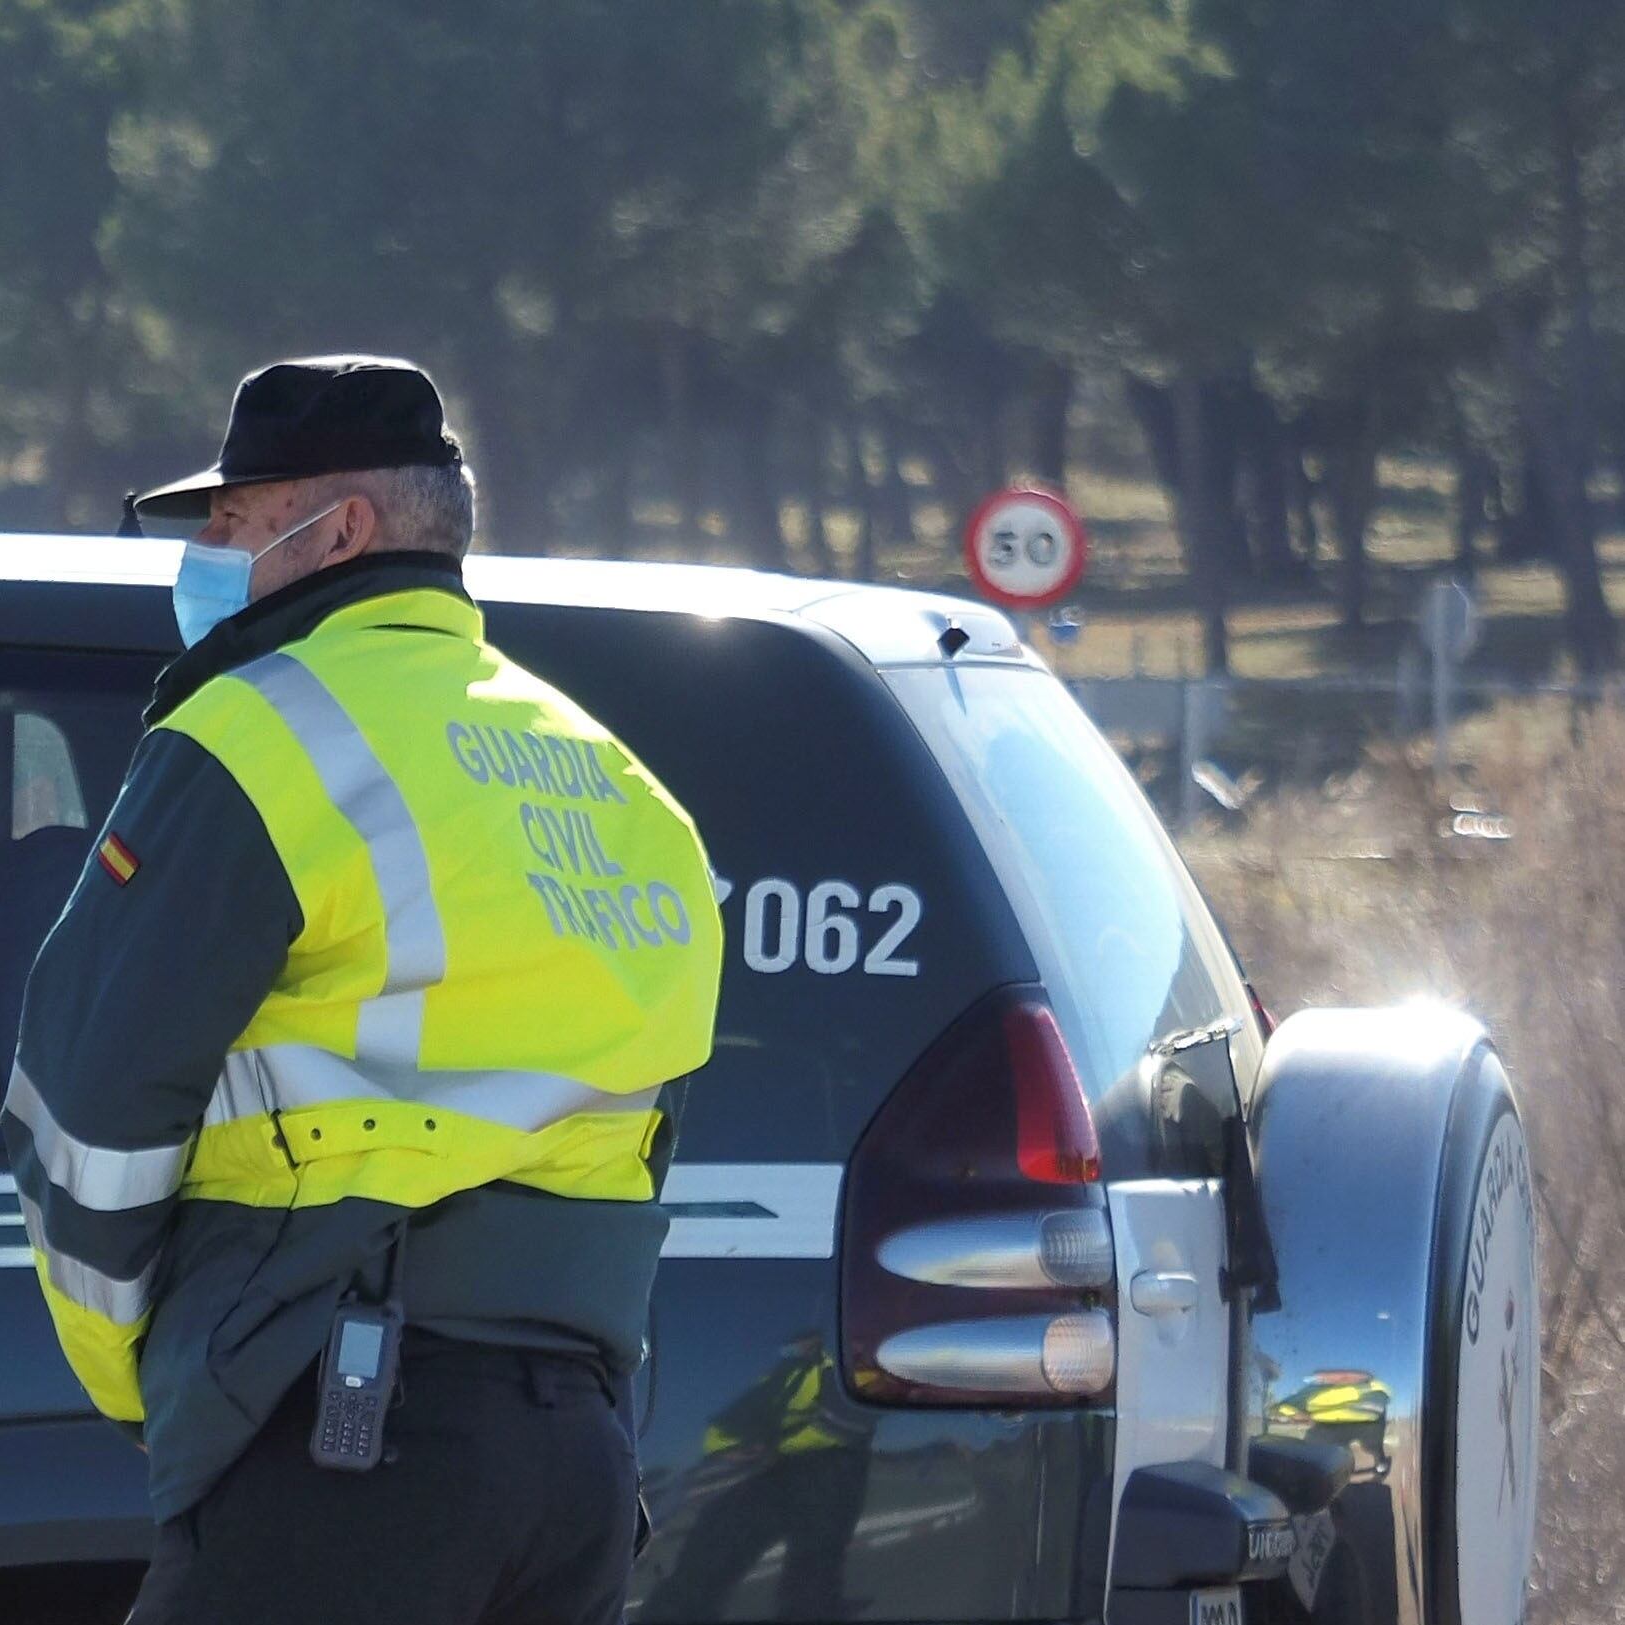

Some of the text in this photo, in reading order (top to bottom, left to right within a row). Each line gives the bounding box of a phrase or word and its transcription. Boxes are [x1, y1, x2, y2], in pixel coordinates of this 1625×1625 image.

[988, 529, 1057, 567] 50
[446, 721, 629, 804] GUARDIA
[520, 802, 625, 878] CIVIL
[525, 870, 691, 951] TRAFICO
[713, 877, 920, 977] 062
